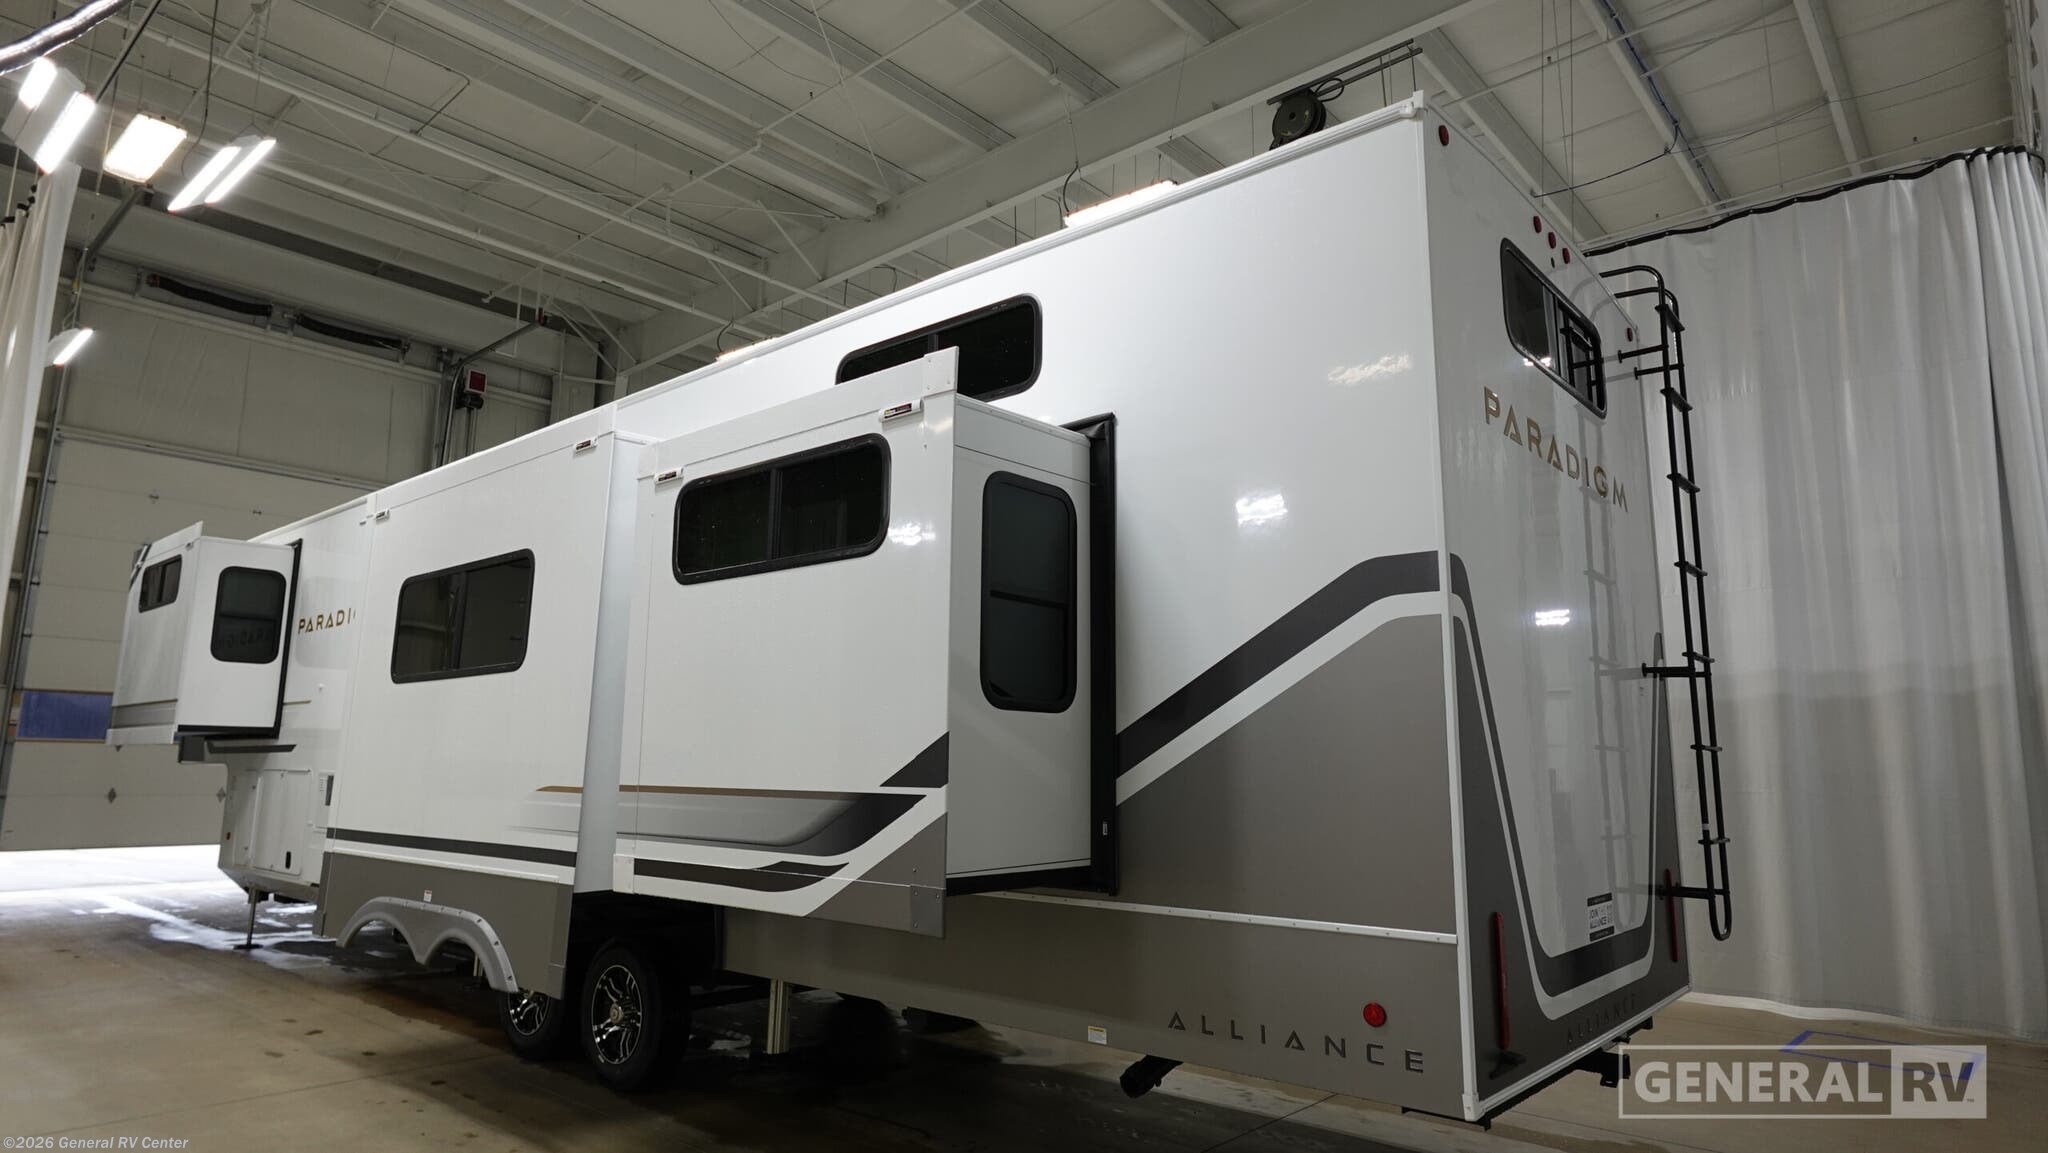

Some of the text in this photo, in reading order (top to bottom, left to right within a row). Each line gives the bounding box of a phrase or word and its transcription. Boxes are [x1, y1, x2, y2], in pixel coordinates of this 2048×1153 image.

[1484, 386, 1628, 512] PARADIGM
[298, 608, 356, 634] PARADI
[1168, 1011, 1424, 1073] ALLIANCE
